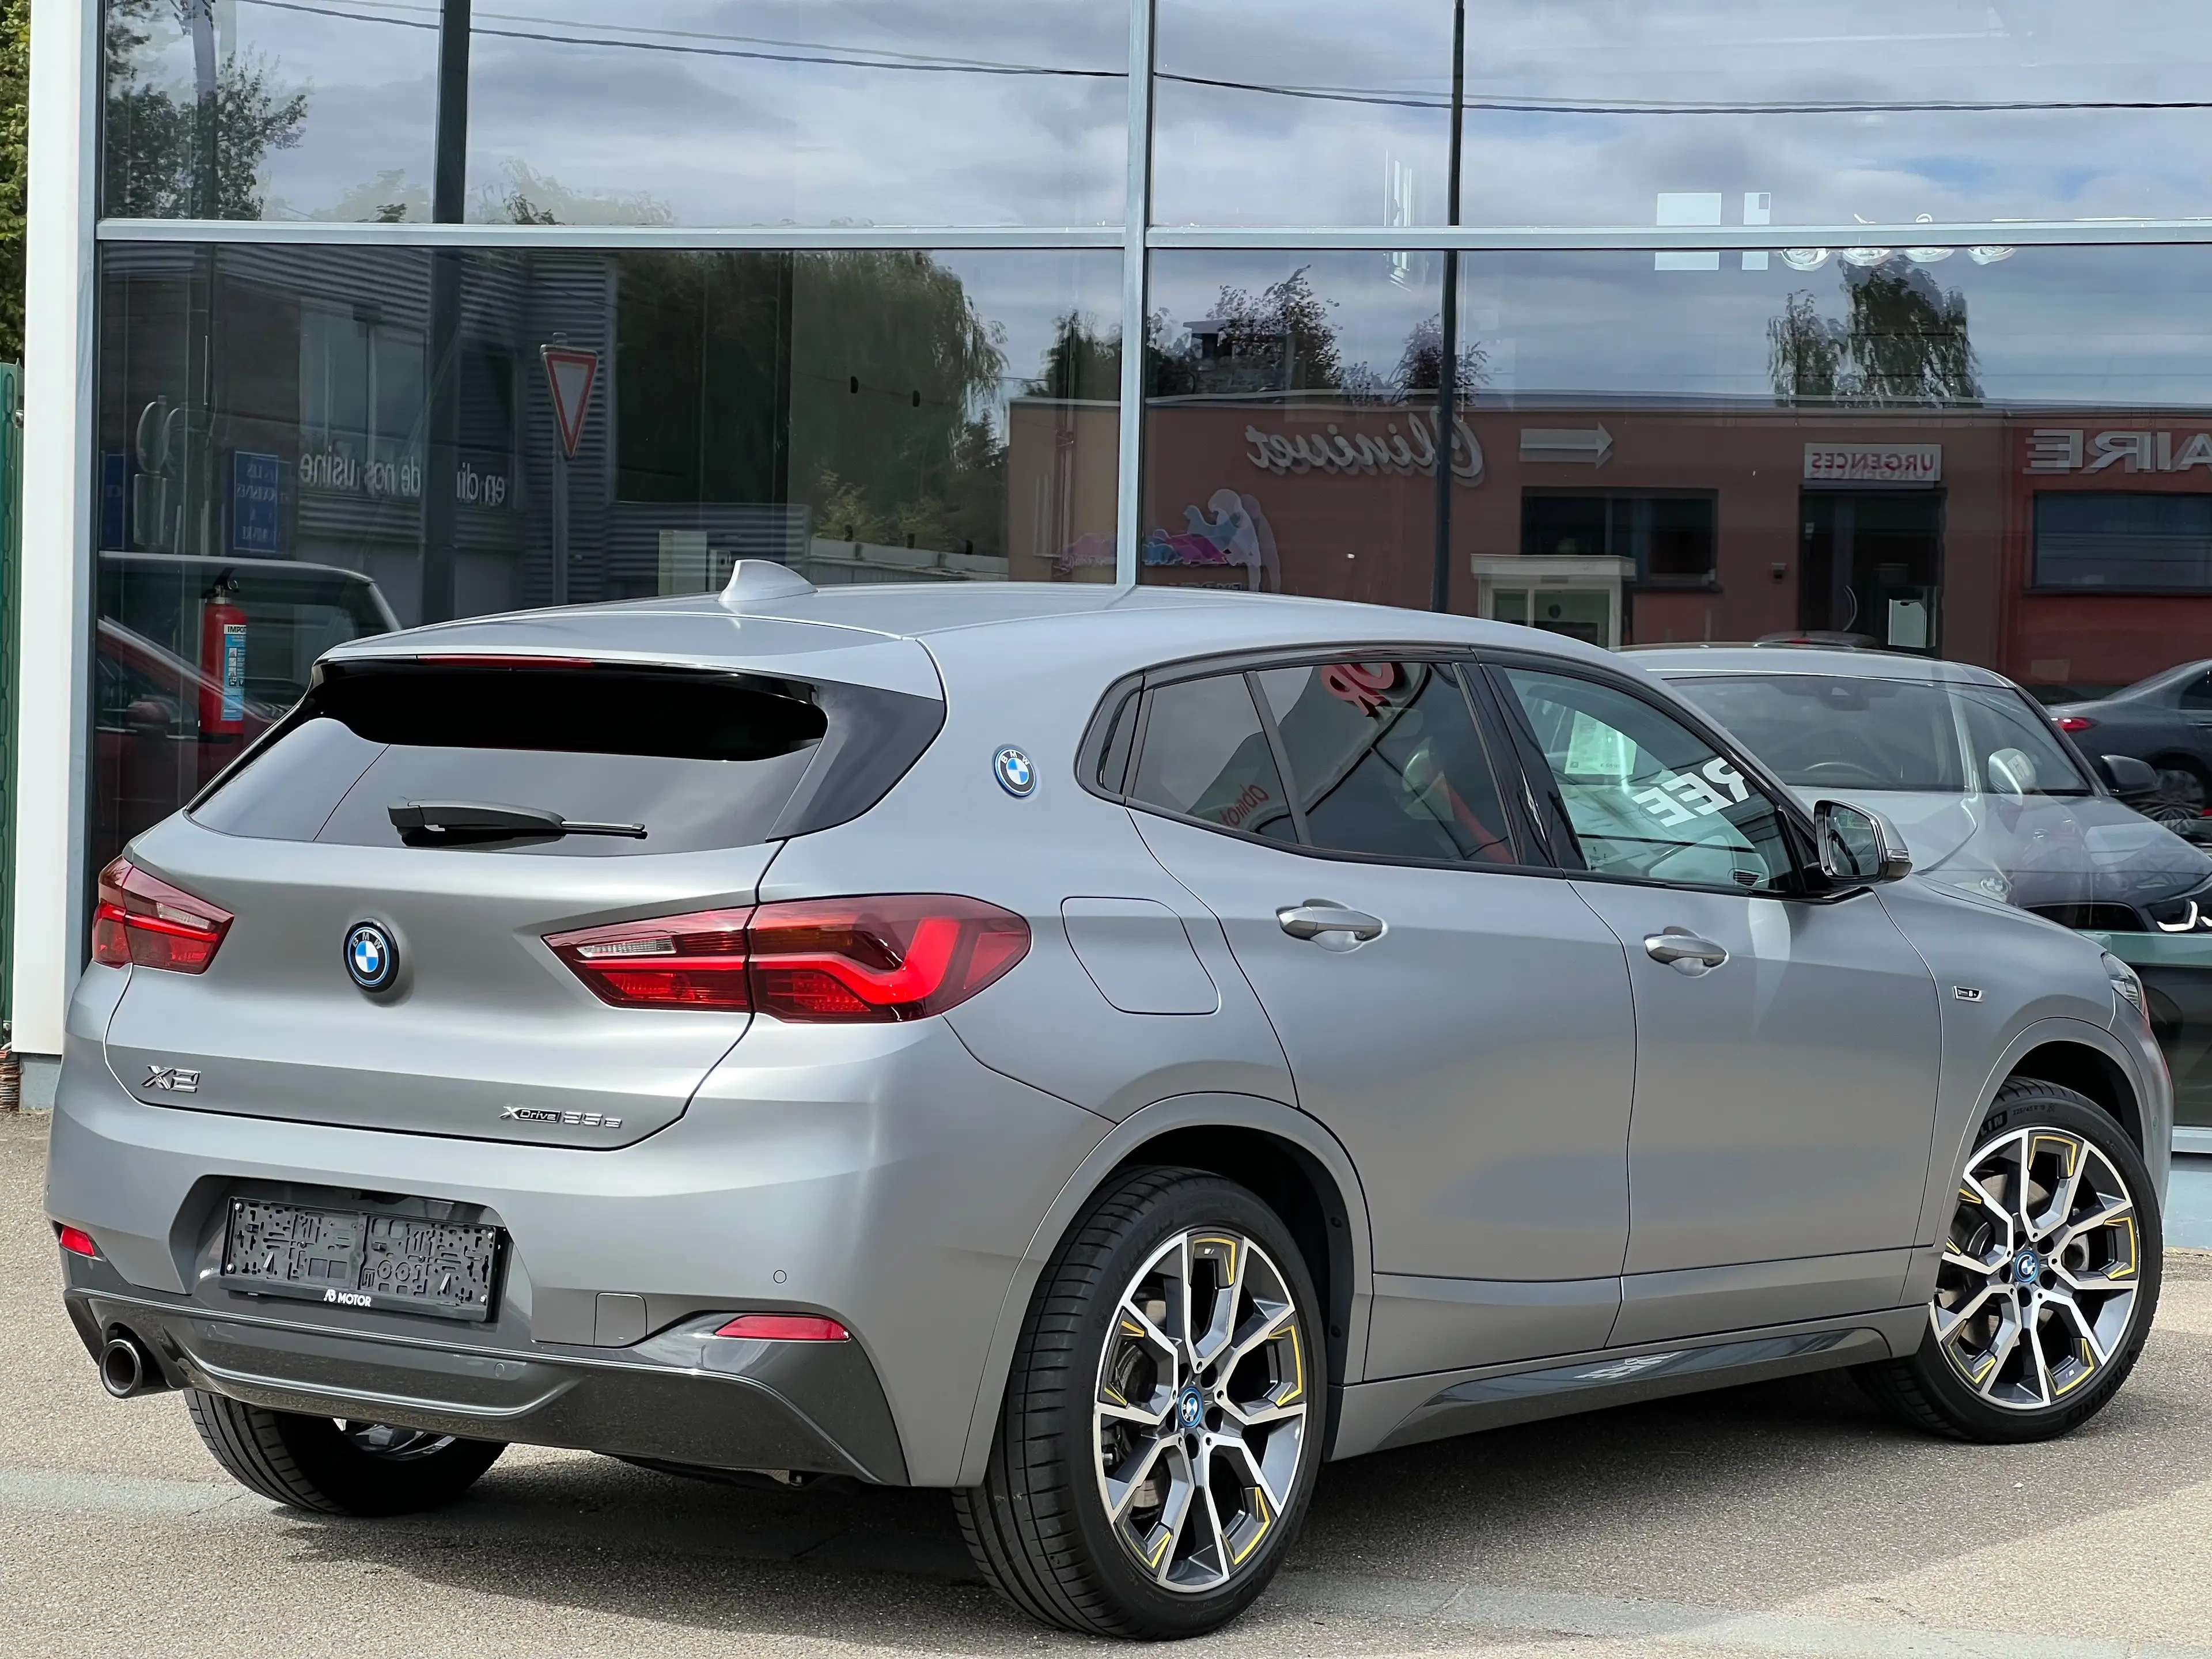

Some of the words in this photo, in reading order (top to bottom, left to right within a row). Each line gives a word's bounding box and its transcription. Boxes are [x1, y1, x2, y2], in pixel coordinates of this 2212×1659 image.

[1001, 751, 1030, 766] BMW
[351, 931, 382, 949] BMW
[140, 1065, 201, 1093] X2
[338, 1292, 372, 1308] MOTOR
